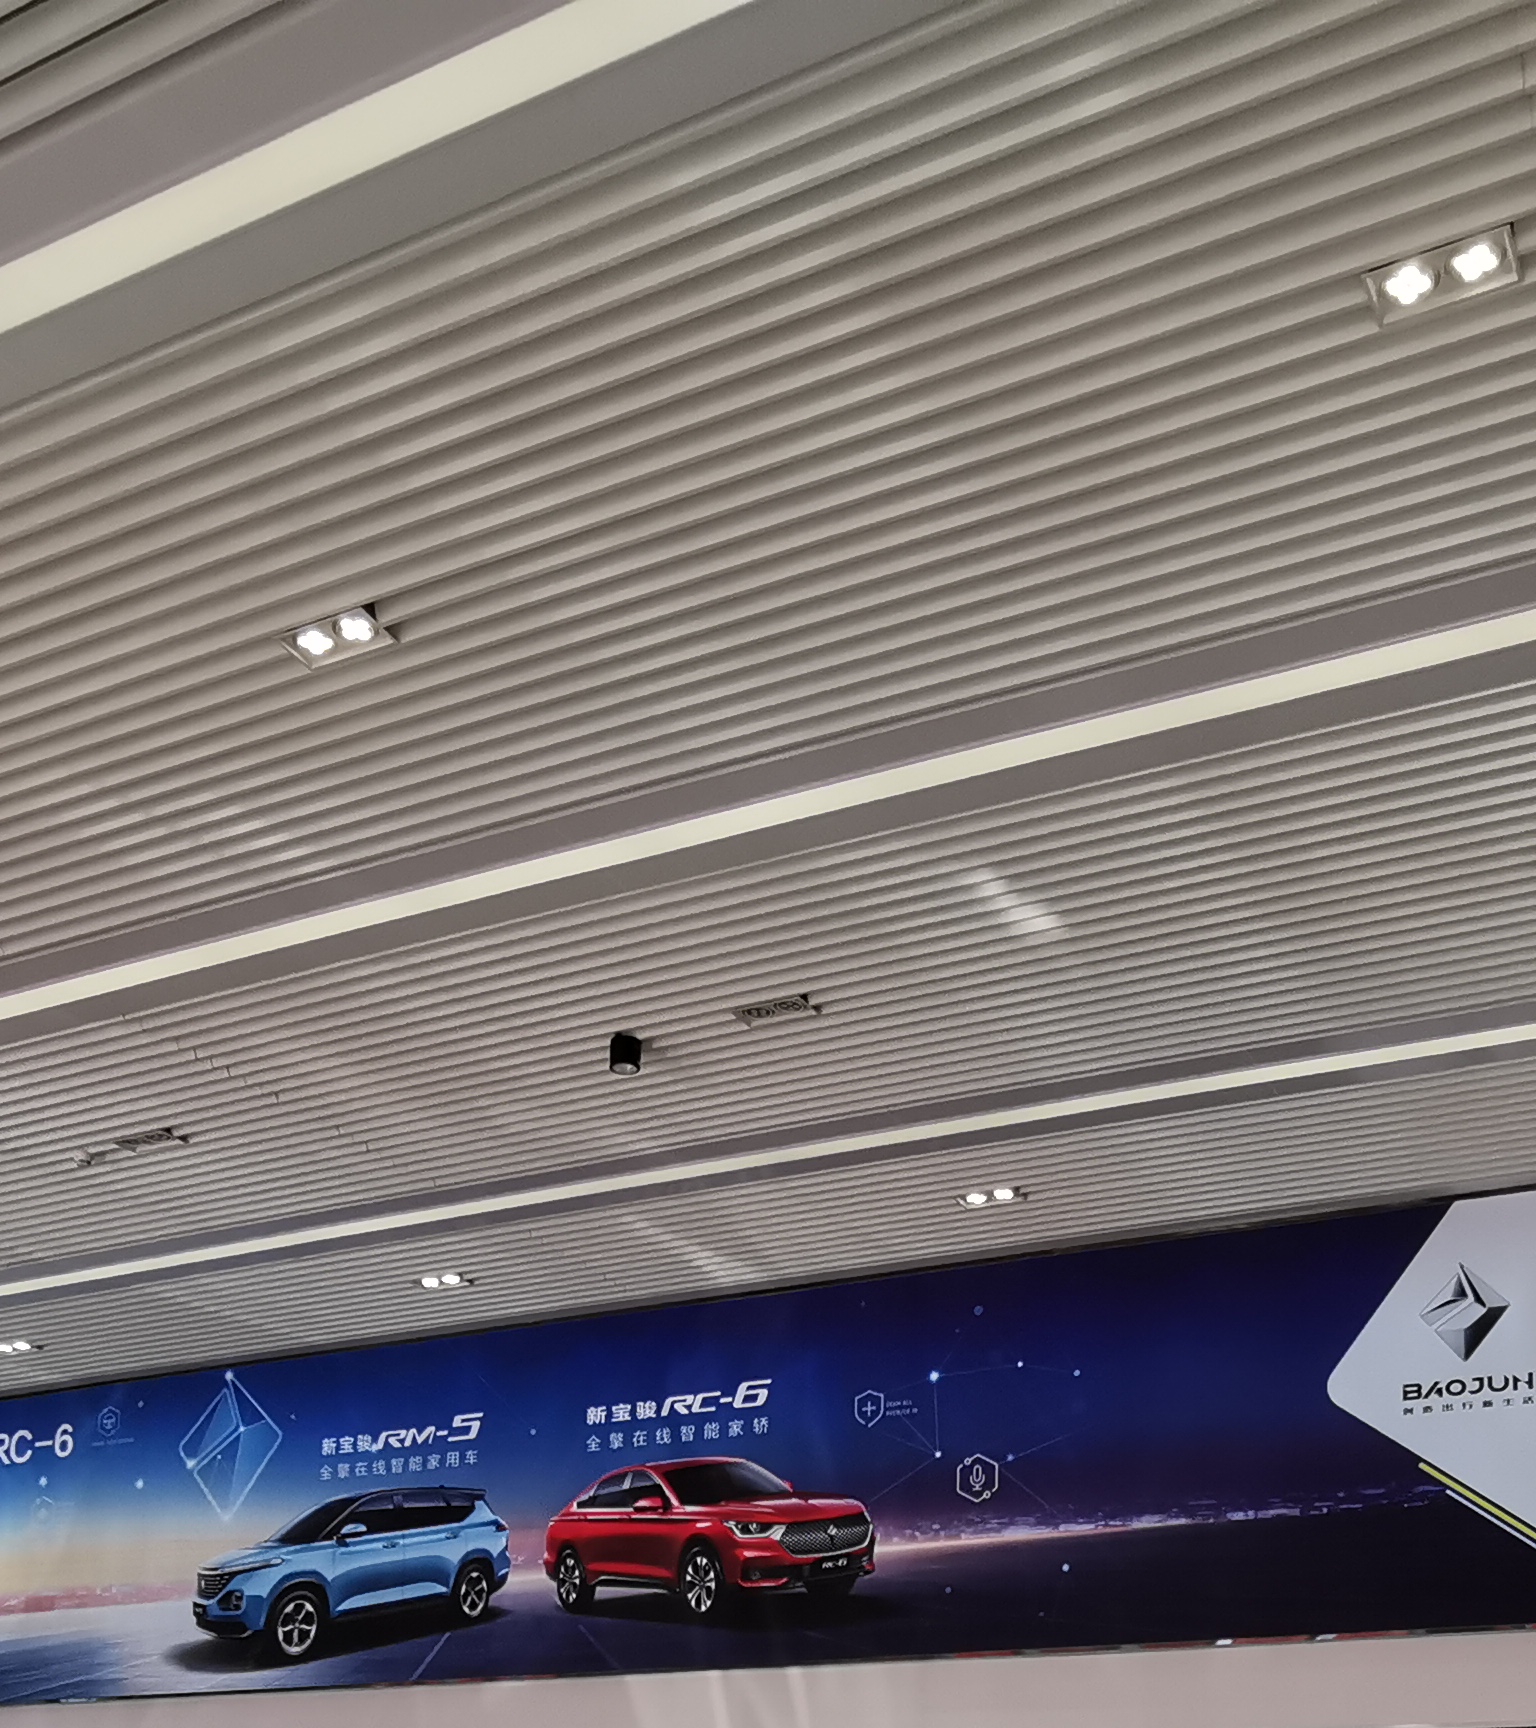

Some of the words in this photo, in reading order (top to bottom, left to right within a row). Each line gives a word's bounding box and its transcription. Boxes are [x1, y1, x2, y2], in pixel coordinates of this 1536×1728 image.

[586, 1400, 658, 1425] 新宝骏
[660, 1379, 772, 1417] RC-6
[1402, 1372, 1534, 1401] BAOJUN
[321, 1434, 372, 1456] 新宝骏
[373, 1412, 484, 1451] RM-5
[586, 1417, 770, 1452] 全擎在线智能家轿
[319, 1450, 479, 1481] 全擎在线智能家用车
